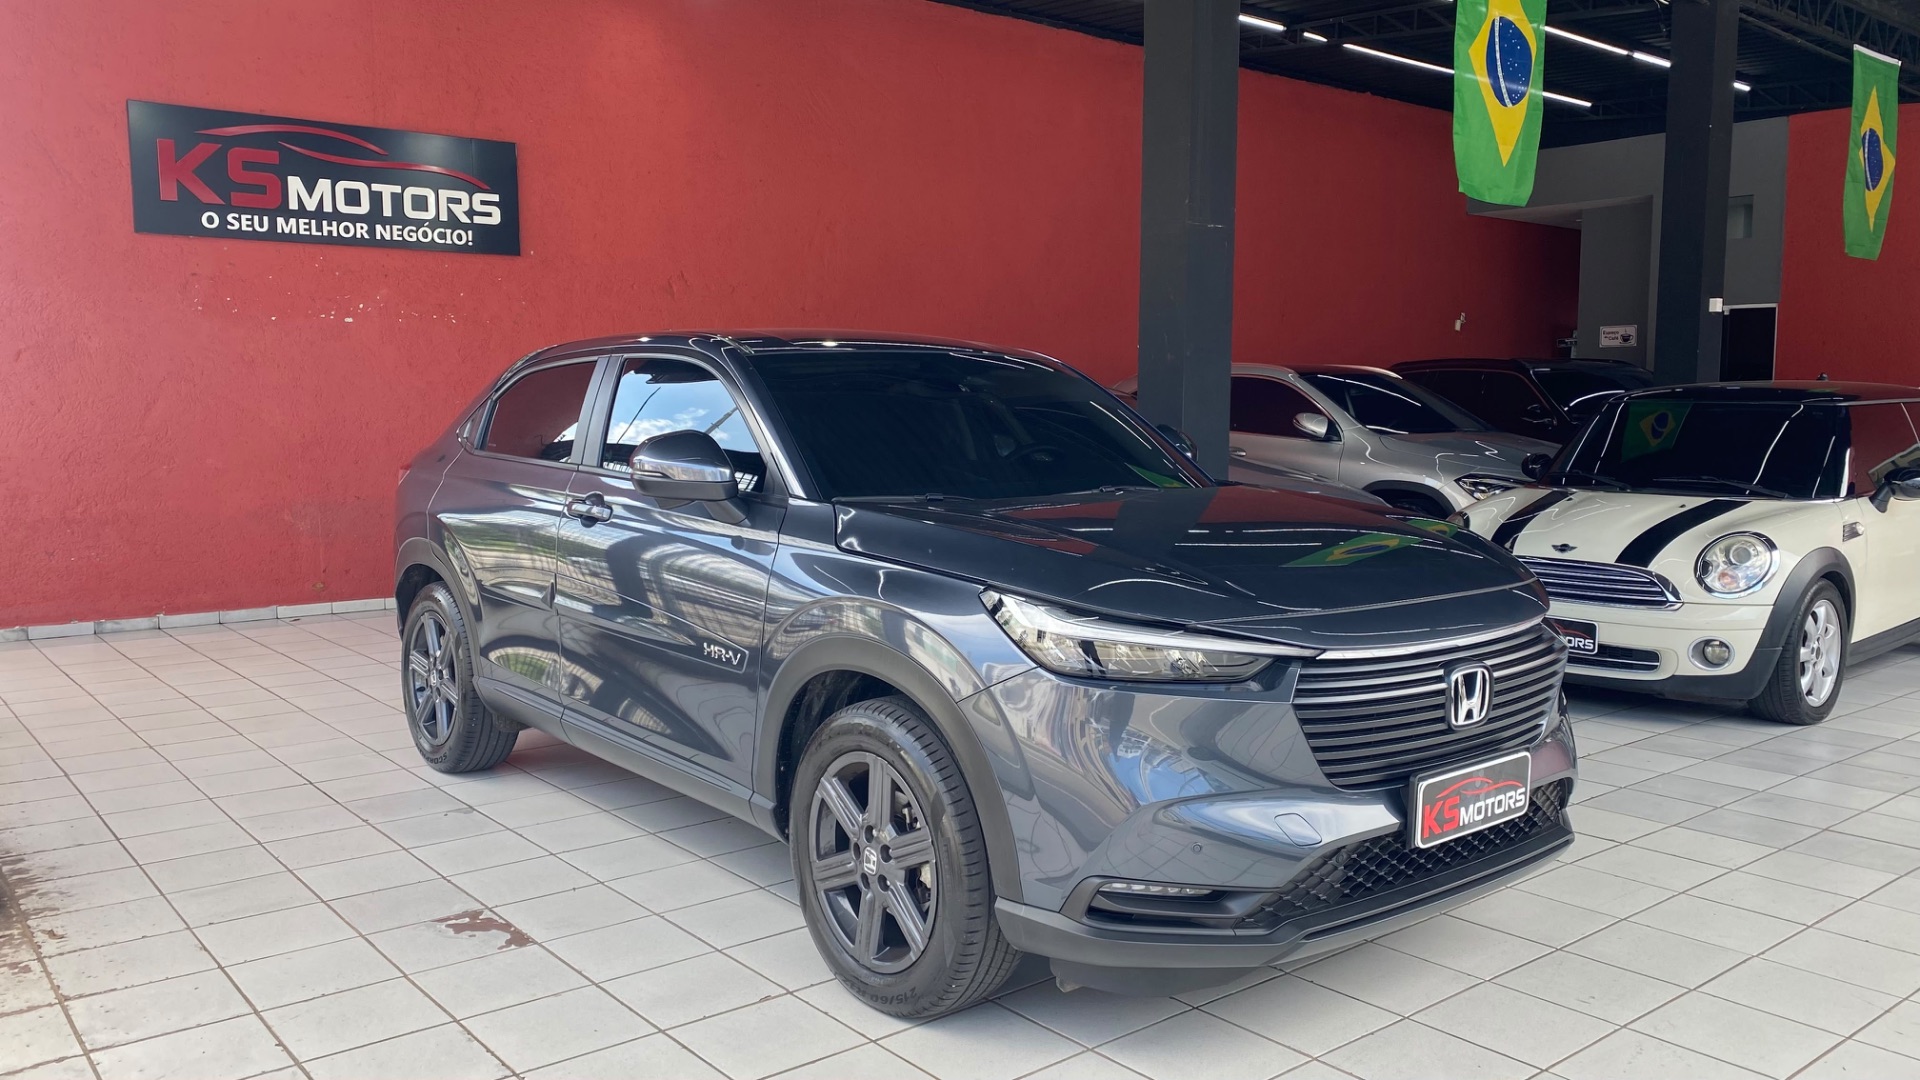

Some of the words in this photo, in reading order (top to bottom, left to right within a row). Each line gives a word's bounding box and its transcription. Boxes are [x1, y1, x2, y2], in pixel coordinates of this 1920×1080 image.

[156, 138, 283, 210] KS
[287, 175, 501, 225] MOTORS
[201, 211, 219, 229] O
[226, 212, 269, 232] SEU
[276, 217, 370, 240] MELHOR
[375, 222, 473, 245] NEGÓCIO!
[703, 642, 741, 665] HR-V
[1422, 795, 1460, 839] KS
[1459, 787, 1526, 827] MOTORS
